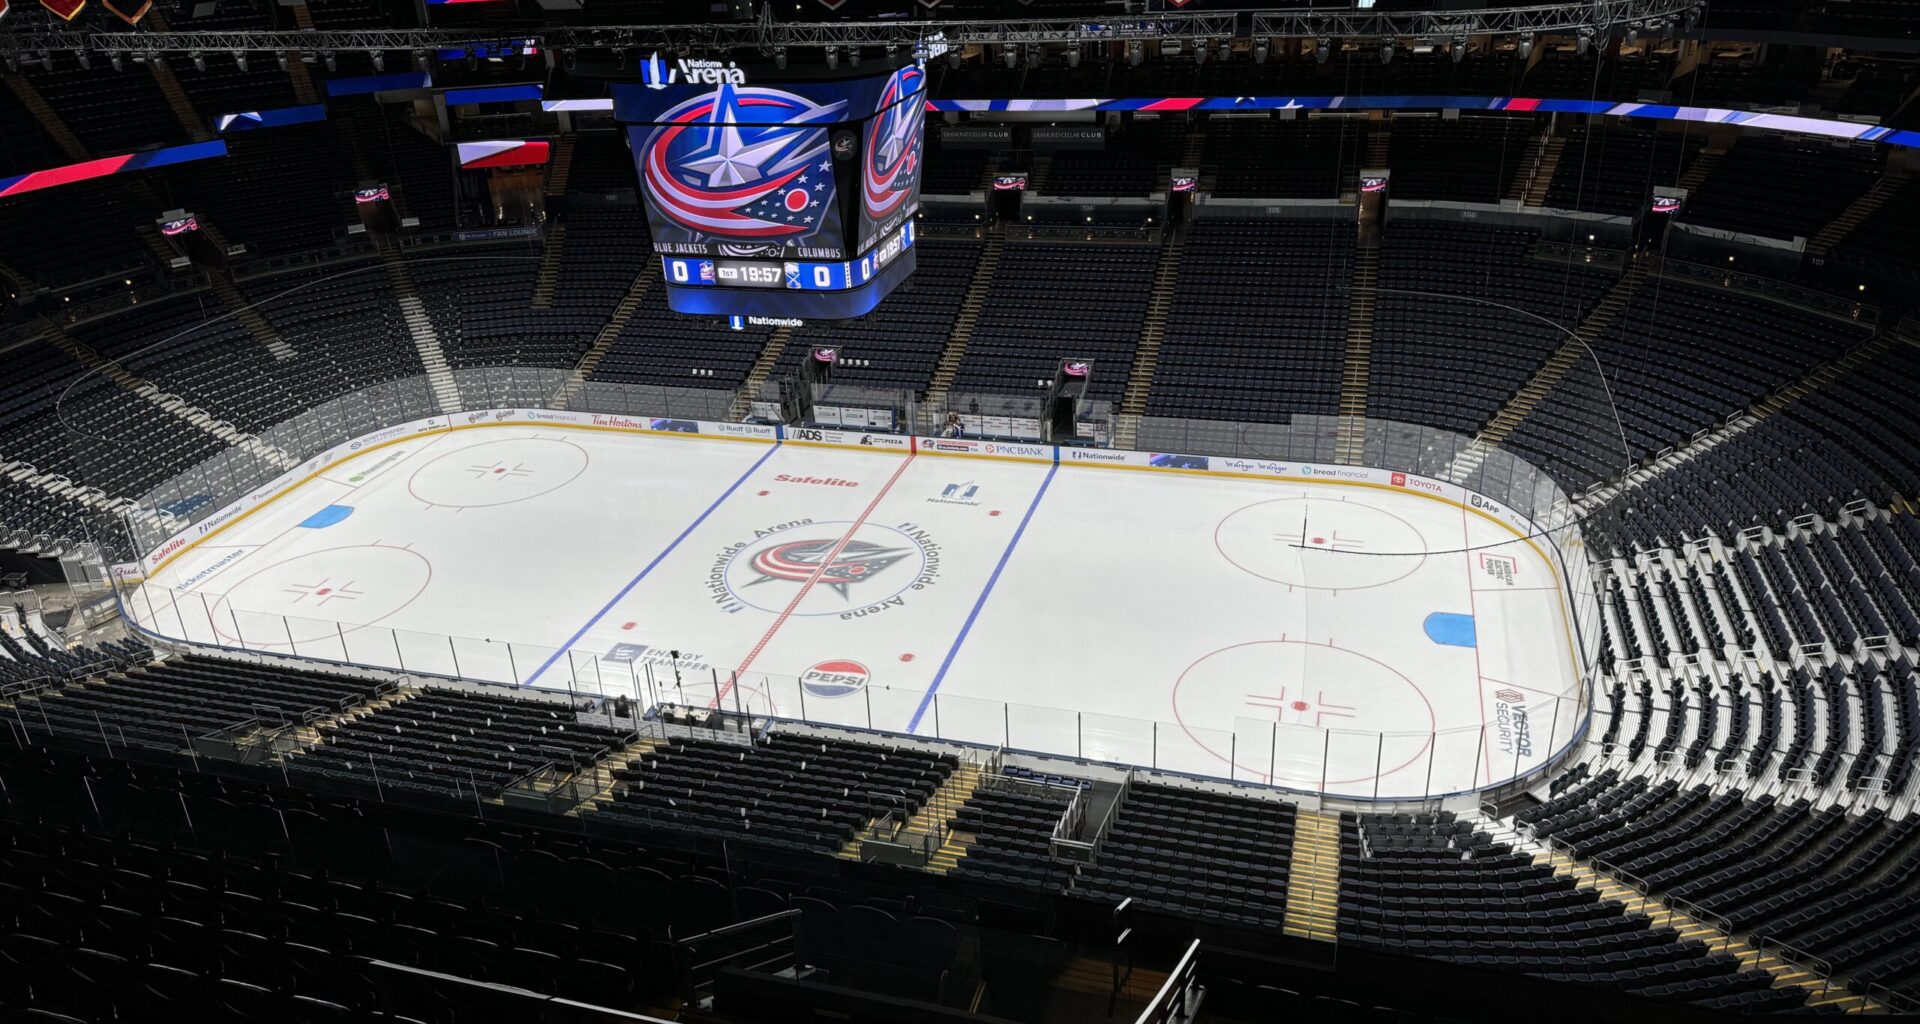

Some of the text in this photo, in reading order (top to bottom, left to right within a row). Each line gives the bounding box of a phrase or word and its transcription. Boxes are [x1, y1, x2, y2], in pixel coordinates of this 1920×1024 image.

[653, 242, 708, 254] BLUE JACKETS
[797, 247, 841, 258] COLUMBUS
[672, 260, 689, 282] 0
[740, 266, 782, 283] 19:57
[813, 265, 831, 287] 0
[748, 316, 803, 327] Nationwide
[591, 414, 643, 429] Tim Hortons
[799, 429, 822, 441] ADS
[1082, 452, 1125, 461] Nationwide
[774, 474, 859, 488] Safelite
[1313, 468, 1369, 479] bread financial
[1409, 478, 1442, 493] TOYOTA
[926, 497, 979, 507] Nationwide
[208, 505, 242, 528] Nationwide
[753, 517, 814, 539] Arena
[151, 537, 186, 564] Safelite
[909, 529, 942, 591] Nationwide
[174, 548, 245, 593] ticketmaster
[705, 541, 747, 604] Nationwide
[840, 595, 905, 620] Arena
[641, 656, 709, 671] TRANSFER
[806, 671, 866, 687] PEPSI
[1496, 702, 1513, 755] SECURITY
[1511, 705, 1532, 757] VECTOR
